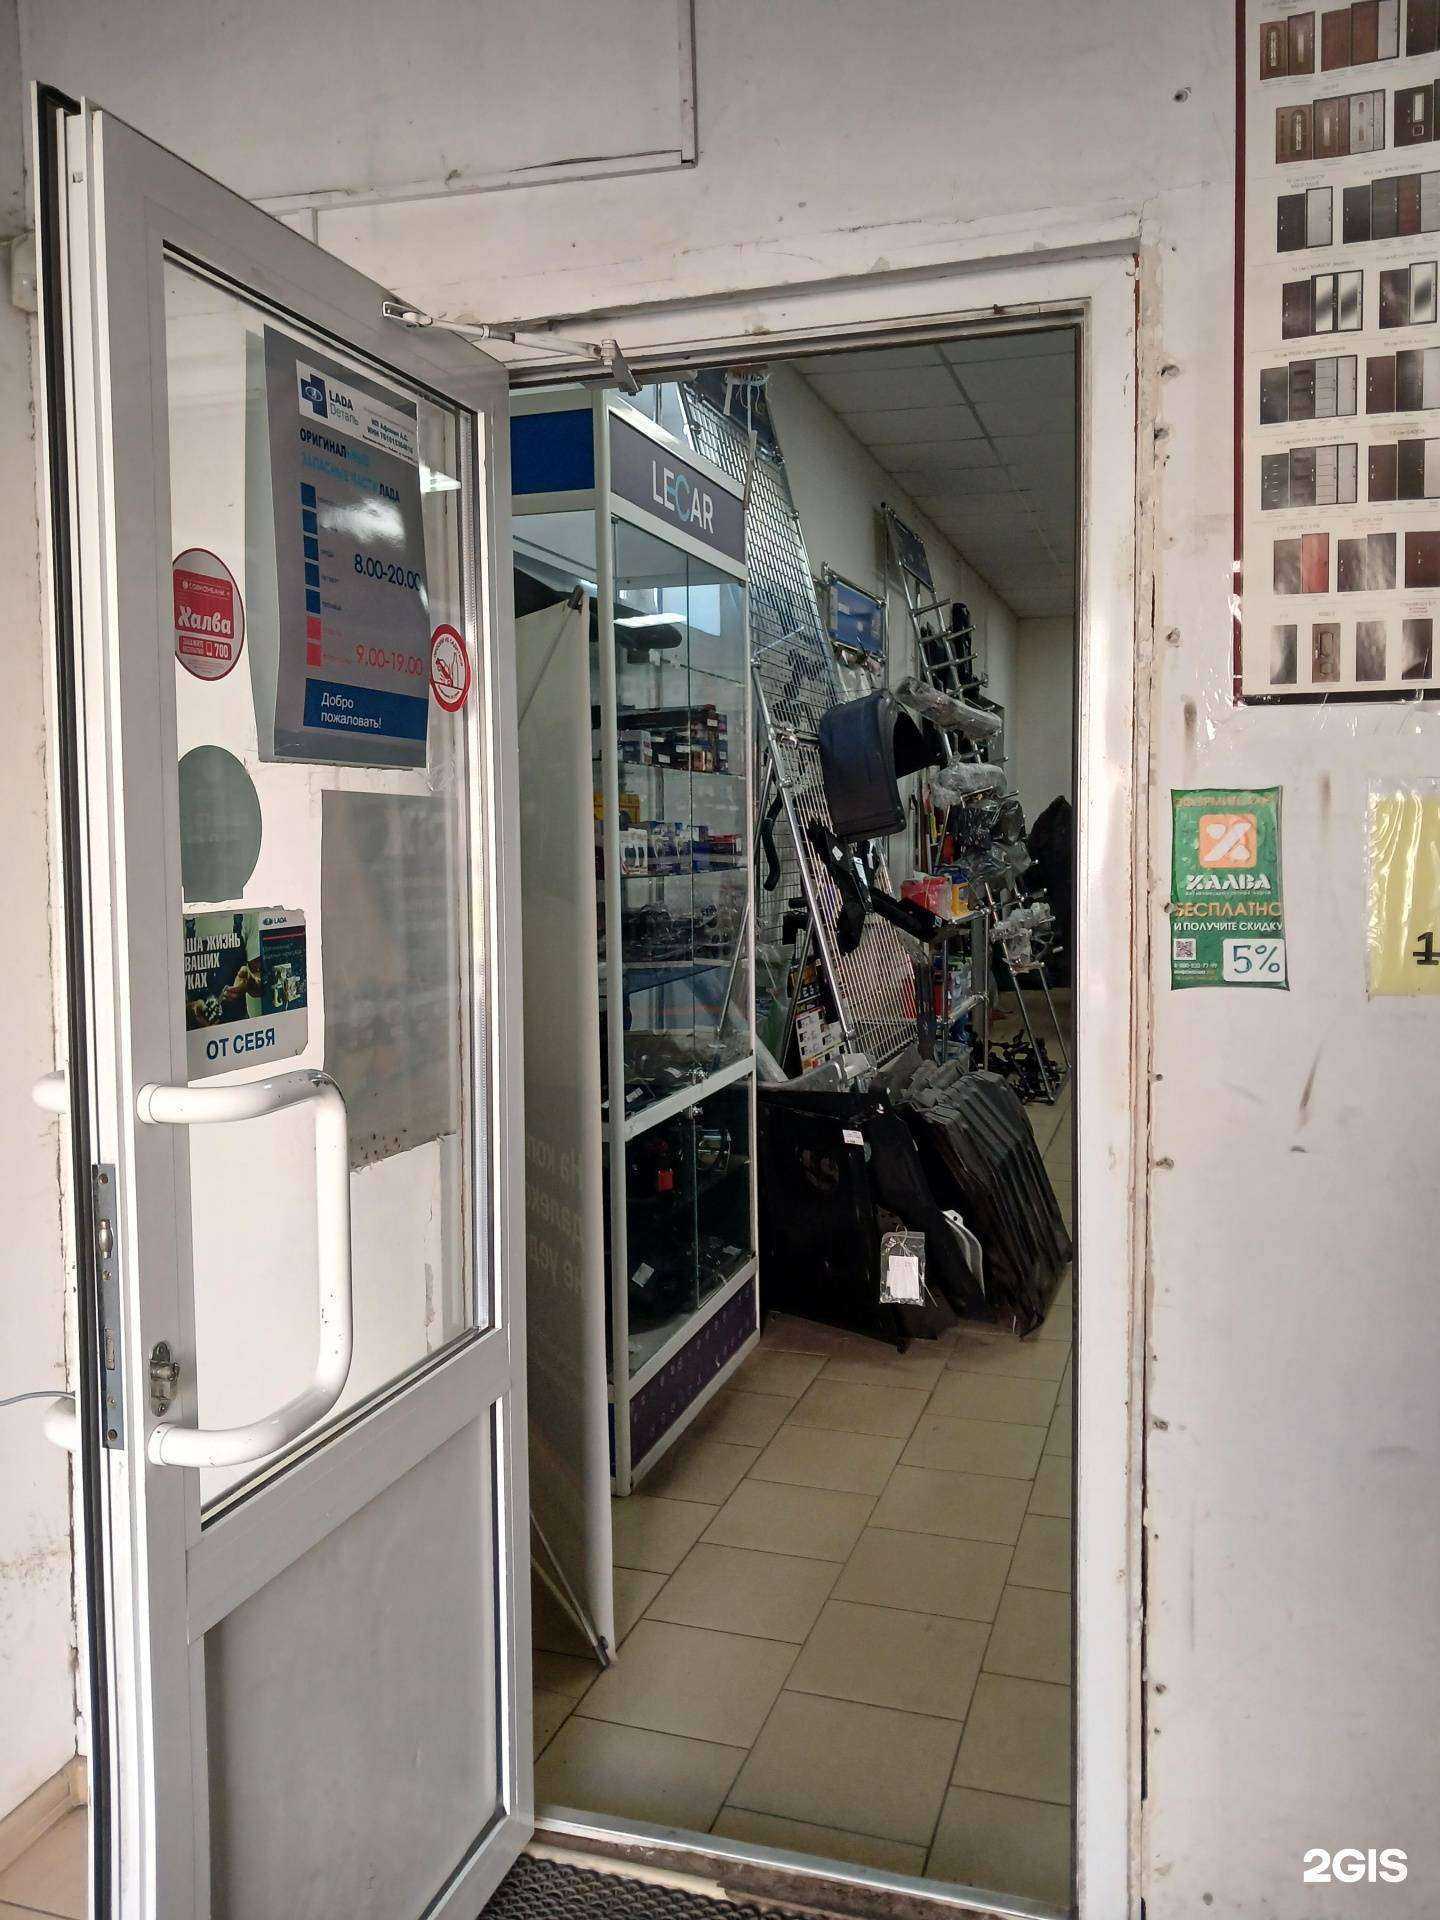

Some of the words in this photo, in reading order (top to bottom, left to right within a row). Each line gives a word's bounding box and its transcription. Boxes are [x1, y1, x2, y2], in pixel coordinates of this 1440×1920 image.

[329, 390, 354, 411] LADA
[380, 483, 400, 502] ЛАДА
[652, 460, 714, 534] LECAR
[353, 553, 422, 592] 8.00-20.00
[178, 605, 231, 635] Халва
[213, 642, 229, 659] 700
[355, 644, 423, 677] 9.00-19.00
[321, 691, 354, 710] Добро
[320, 710, 382, 731] пожаловать!
[1175, 901, 1281, 917] БЕСПЛАТНО
[1174, 922, 1182, 931] И
[1183, 922, 1237, 931] ПОЛУЧИТЕ
[1239, 922, 1284, 931] СКИДКУ
[206, 932, 241, 952] ЖИЗНЬ
[184, 952, 220, 973] ВАШИХ
[1232, 944, 1280, 974] 5%
[206, 1037, 230, 1060] ОТ
[233, 1027, 276, 1054] СЕБЯ
